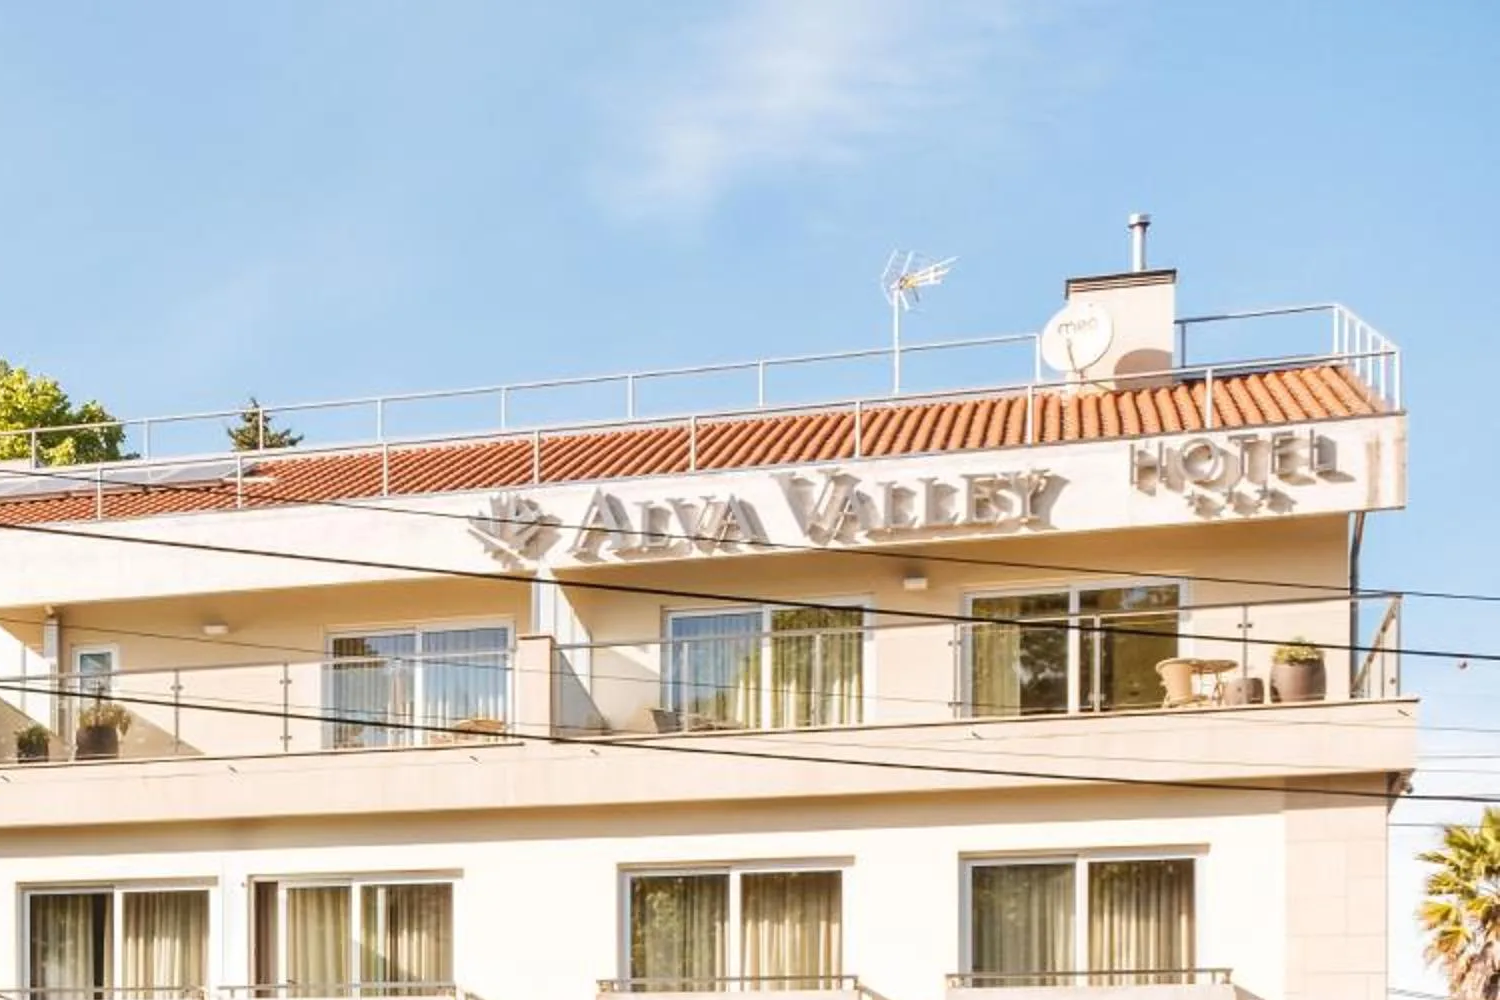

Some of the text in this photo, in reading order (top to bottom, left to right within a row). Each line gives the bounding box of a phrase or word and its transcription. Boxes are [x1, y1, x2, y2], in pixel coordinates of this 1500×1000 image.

[566, 428, 1338, 552] ALVA VALLEY HOTEL
